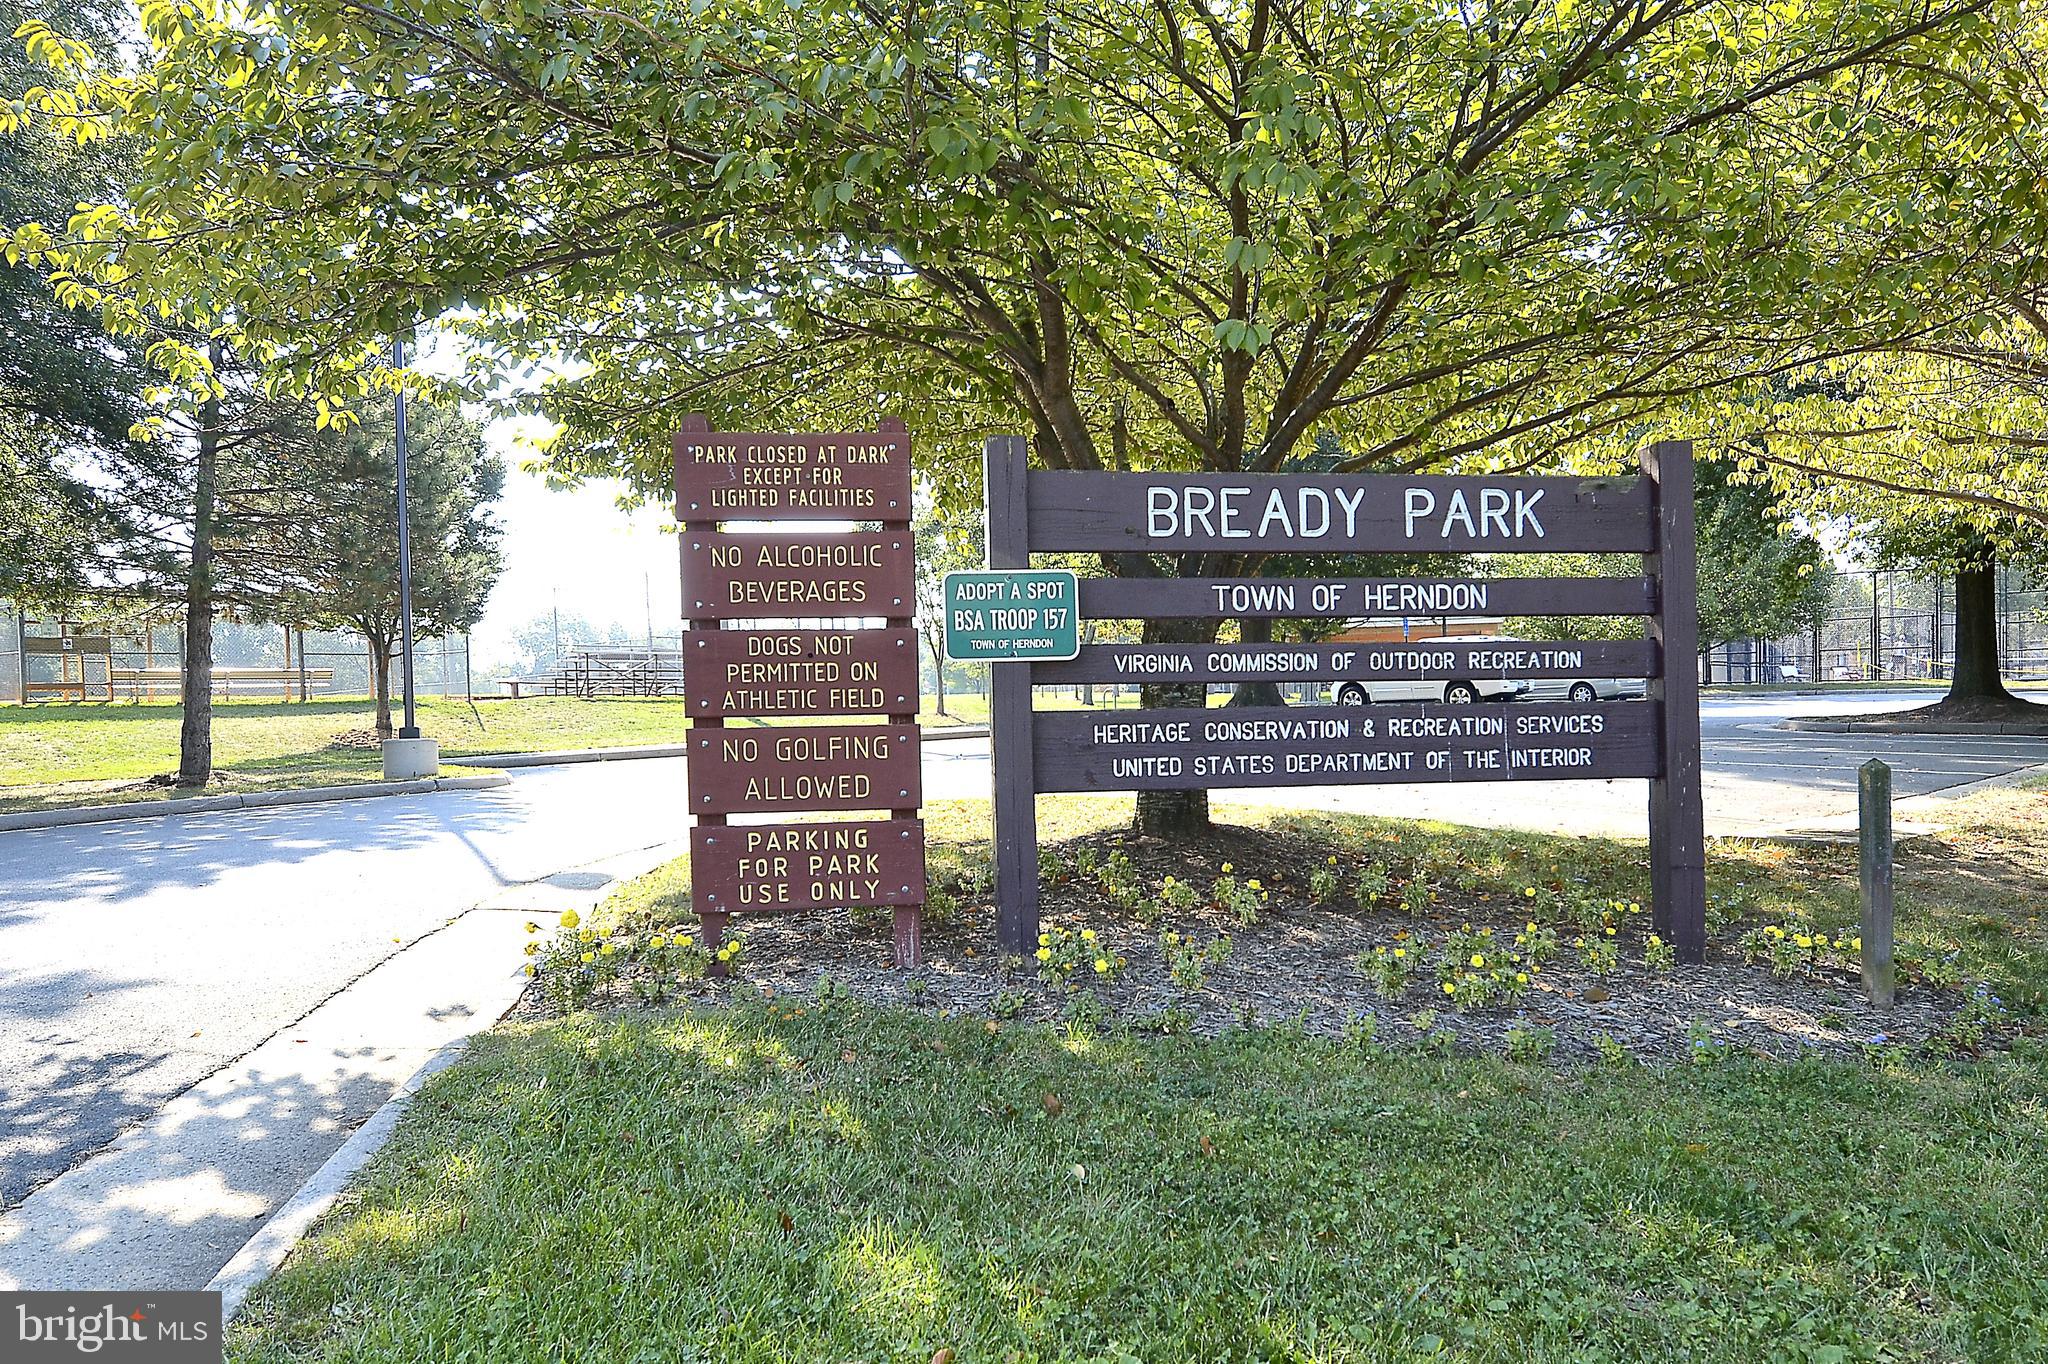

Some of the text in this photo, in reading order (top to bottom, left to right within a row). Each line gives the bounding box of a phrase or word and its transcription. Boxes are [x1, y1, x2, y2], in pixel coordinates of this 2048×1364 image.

[695, 445, 889, 464] PARK CLOSED AT DARK
[743, 467, 842, 485] EXCEPT FOR
[711, 489, 874, 507] LIGHTED FACILITIES
[1146, 486, 1546, 539] BREADY PARK
[710, 545, 882, 568] NO ALCOHOLIC
[729, 580, 866, 603] BEVERAGES
[956, 581, 1065, 600] ADOPT A SPOT
[1211, 583, 1487, 613] TOWN OF HERNDON
[954, 608, 1068, 631] BSA TROOP 157
[748, 635, 854, 657] DOGS NOT
[970, 638, 1053, 650] TOWN OF HERNDON
[727, 661, 878, 683] PERMITTED ON
[1113, 650, 1582, 673] VIRGINIA COMMISSION OF OUTDOOR RECREATION
[722, 688, 885, 710] ATHLETIC FIELD
[1093, 714, 1604, 744] HERITAGE CONSERVATION & RECREATION SERVICES
[722, 735, 888, 762] NO GOLFING
[1112, 747, 1592, 777] UNITED STATES DEPARTMENT OF THE INTERIOR
[744, 774, 870, 800] ALLOWED
[747, 829, 868, 852] PARKING
[738, 853, 880, 878] FOR PARK
[739, 879, 880, 904] USE ONLY
